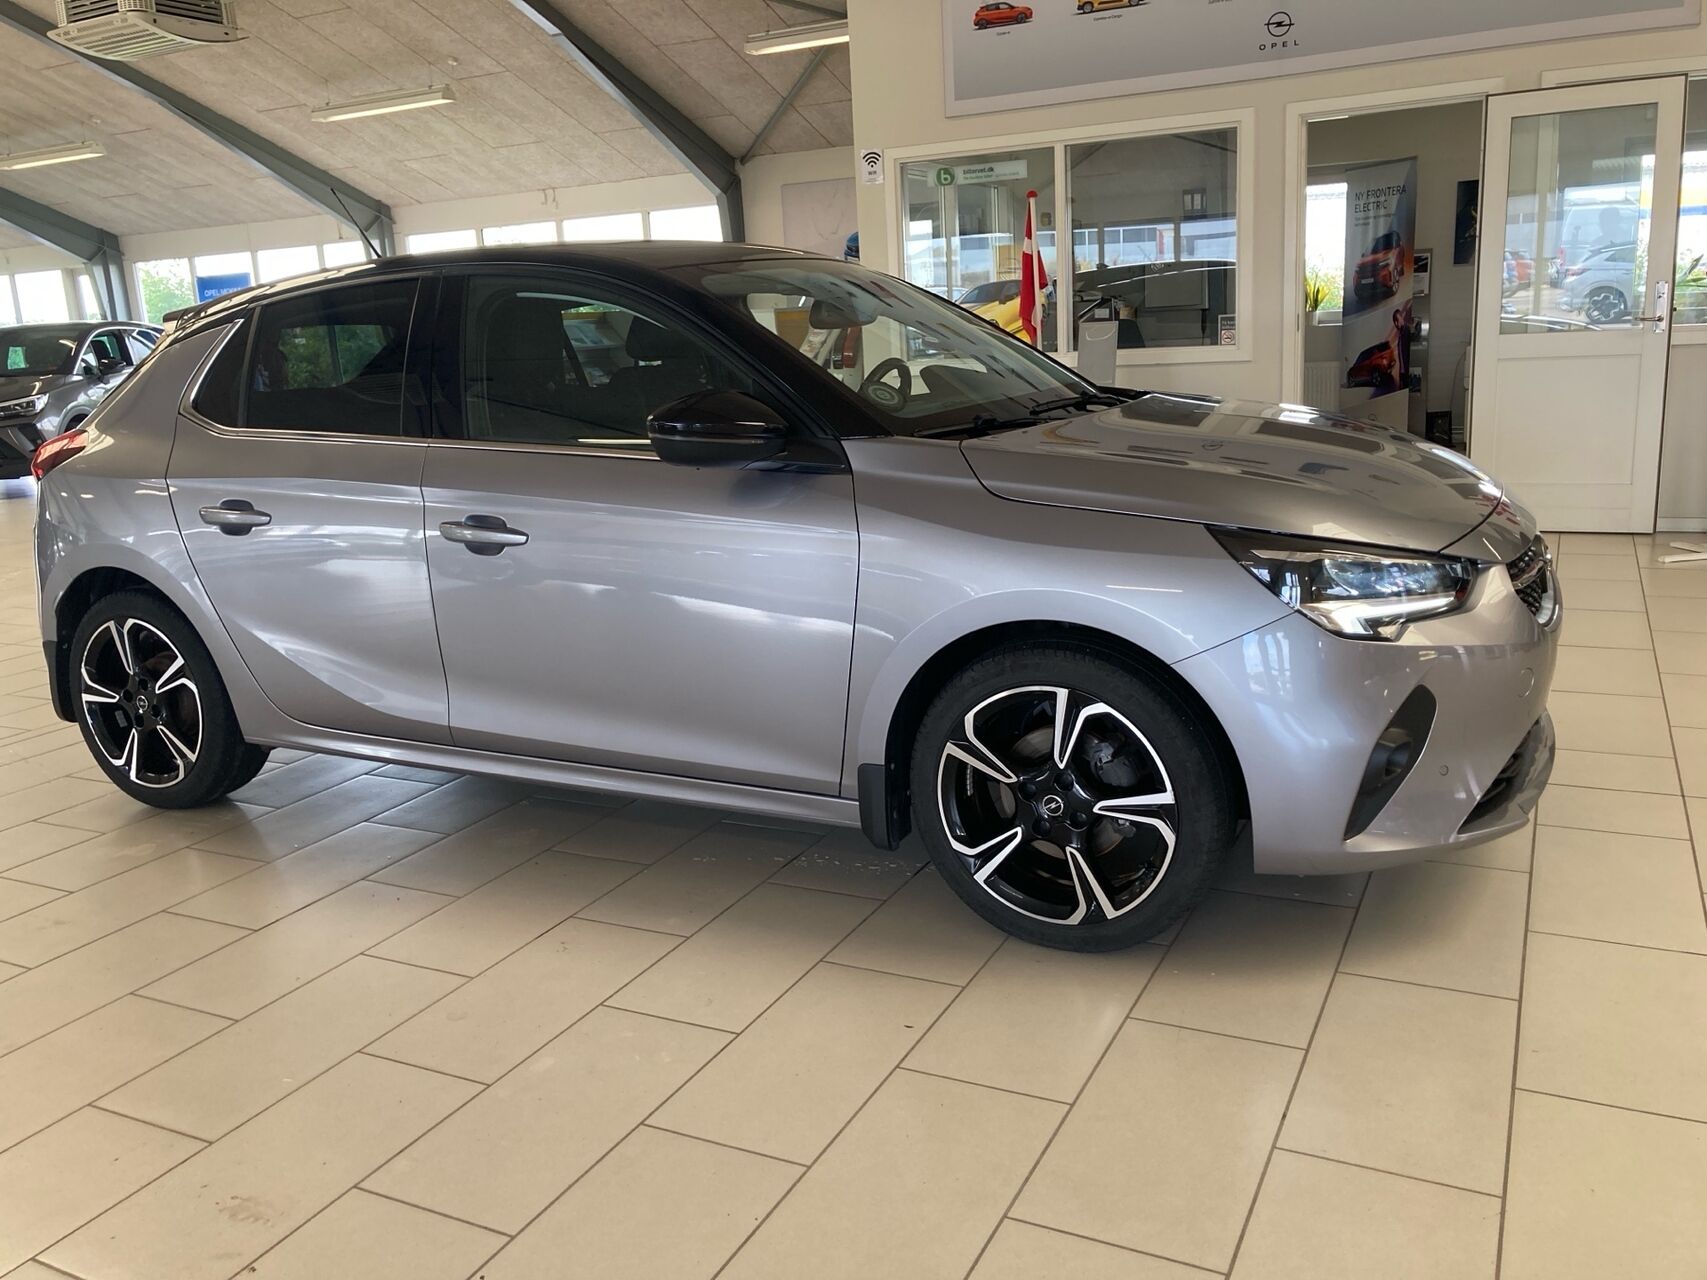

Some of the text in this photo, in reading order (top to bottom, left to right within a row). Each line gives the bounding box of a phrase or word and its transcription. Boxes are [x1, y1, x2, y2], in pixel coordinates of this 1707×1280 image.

[1258, 39, 1299, 51] OPEL
[1355, 184, 1407, 201] NY FRONTERA
[1354, 199, 1388, 214] ELECTRIC
[204, 288, 220, 297] OPEL
